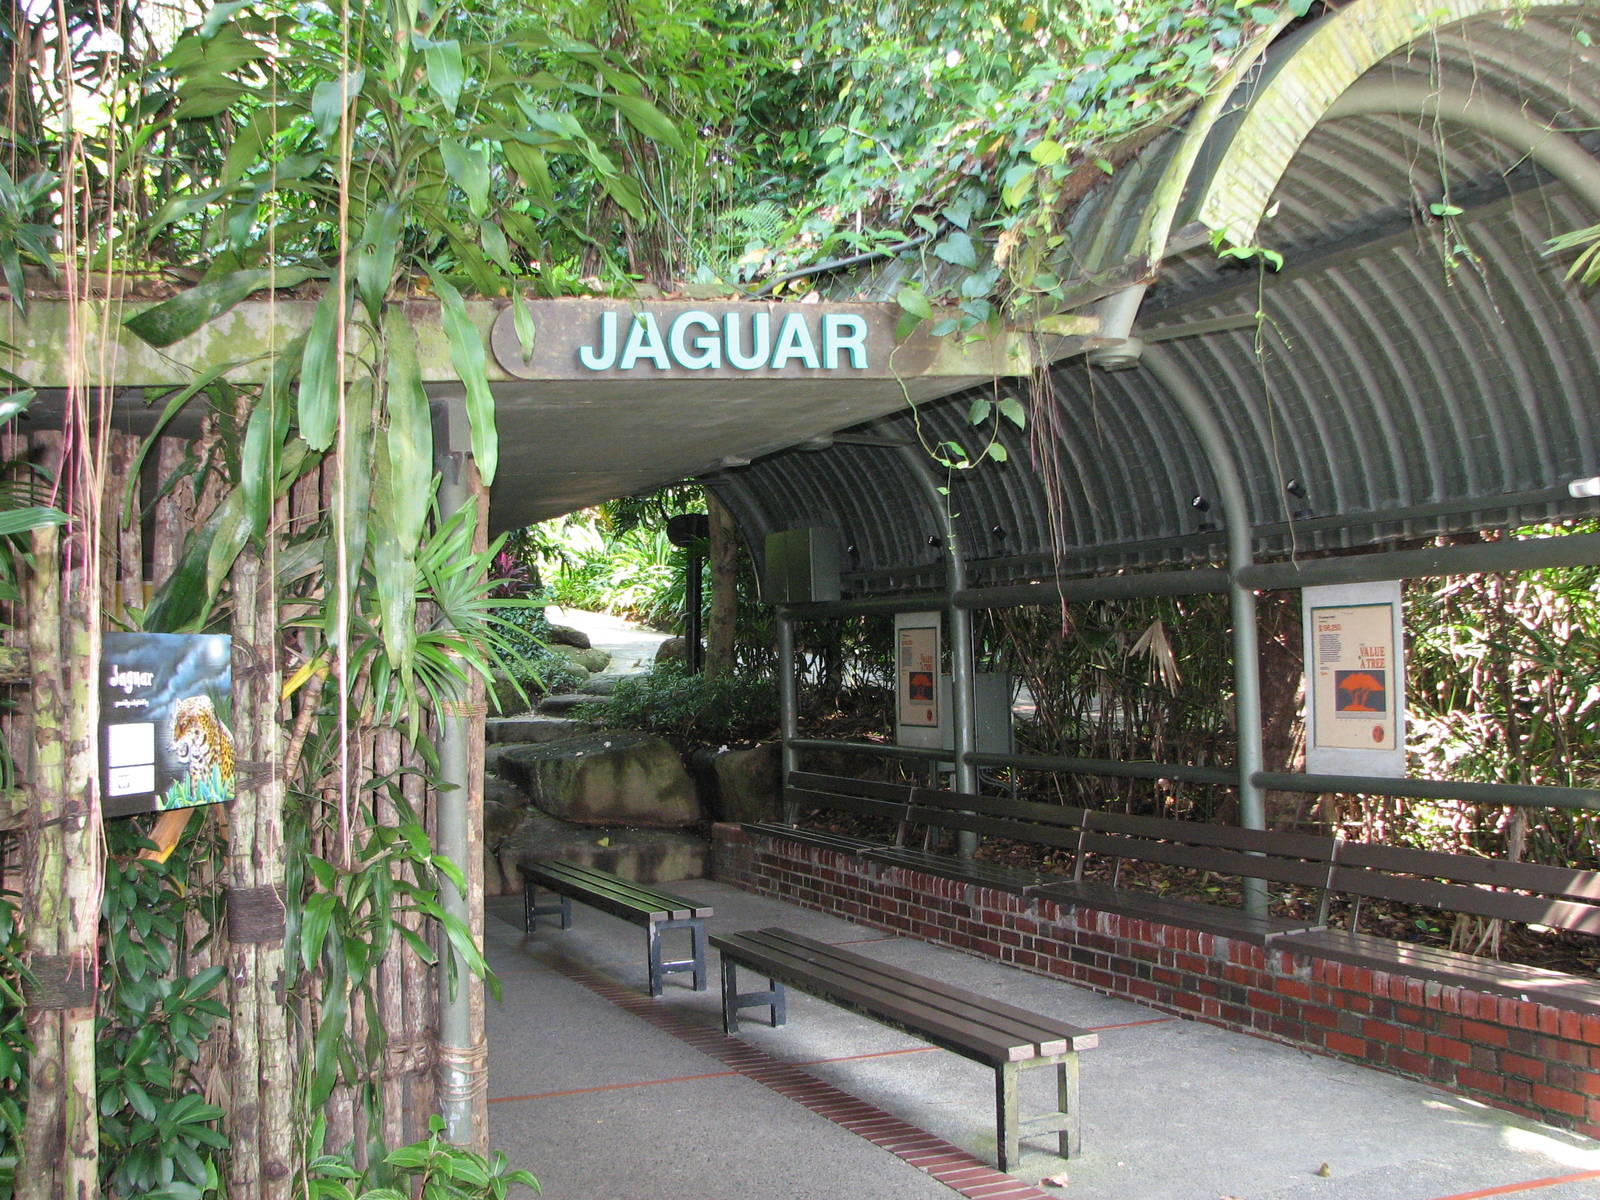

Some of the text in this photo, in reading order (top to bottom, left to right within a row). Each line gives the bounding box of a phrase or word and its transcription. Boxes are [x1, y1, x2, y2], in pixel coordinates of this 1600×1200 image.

[579, 310, 870, 371] JAGUAR
[1360, 647, 1385, 657] VALUE
[1360, 658, 1386, 669] A TREE
[109, 664, 155, 694] Jaguar
